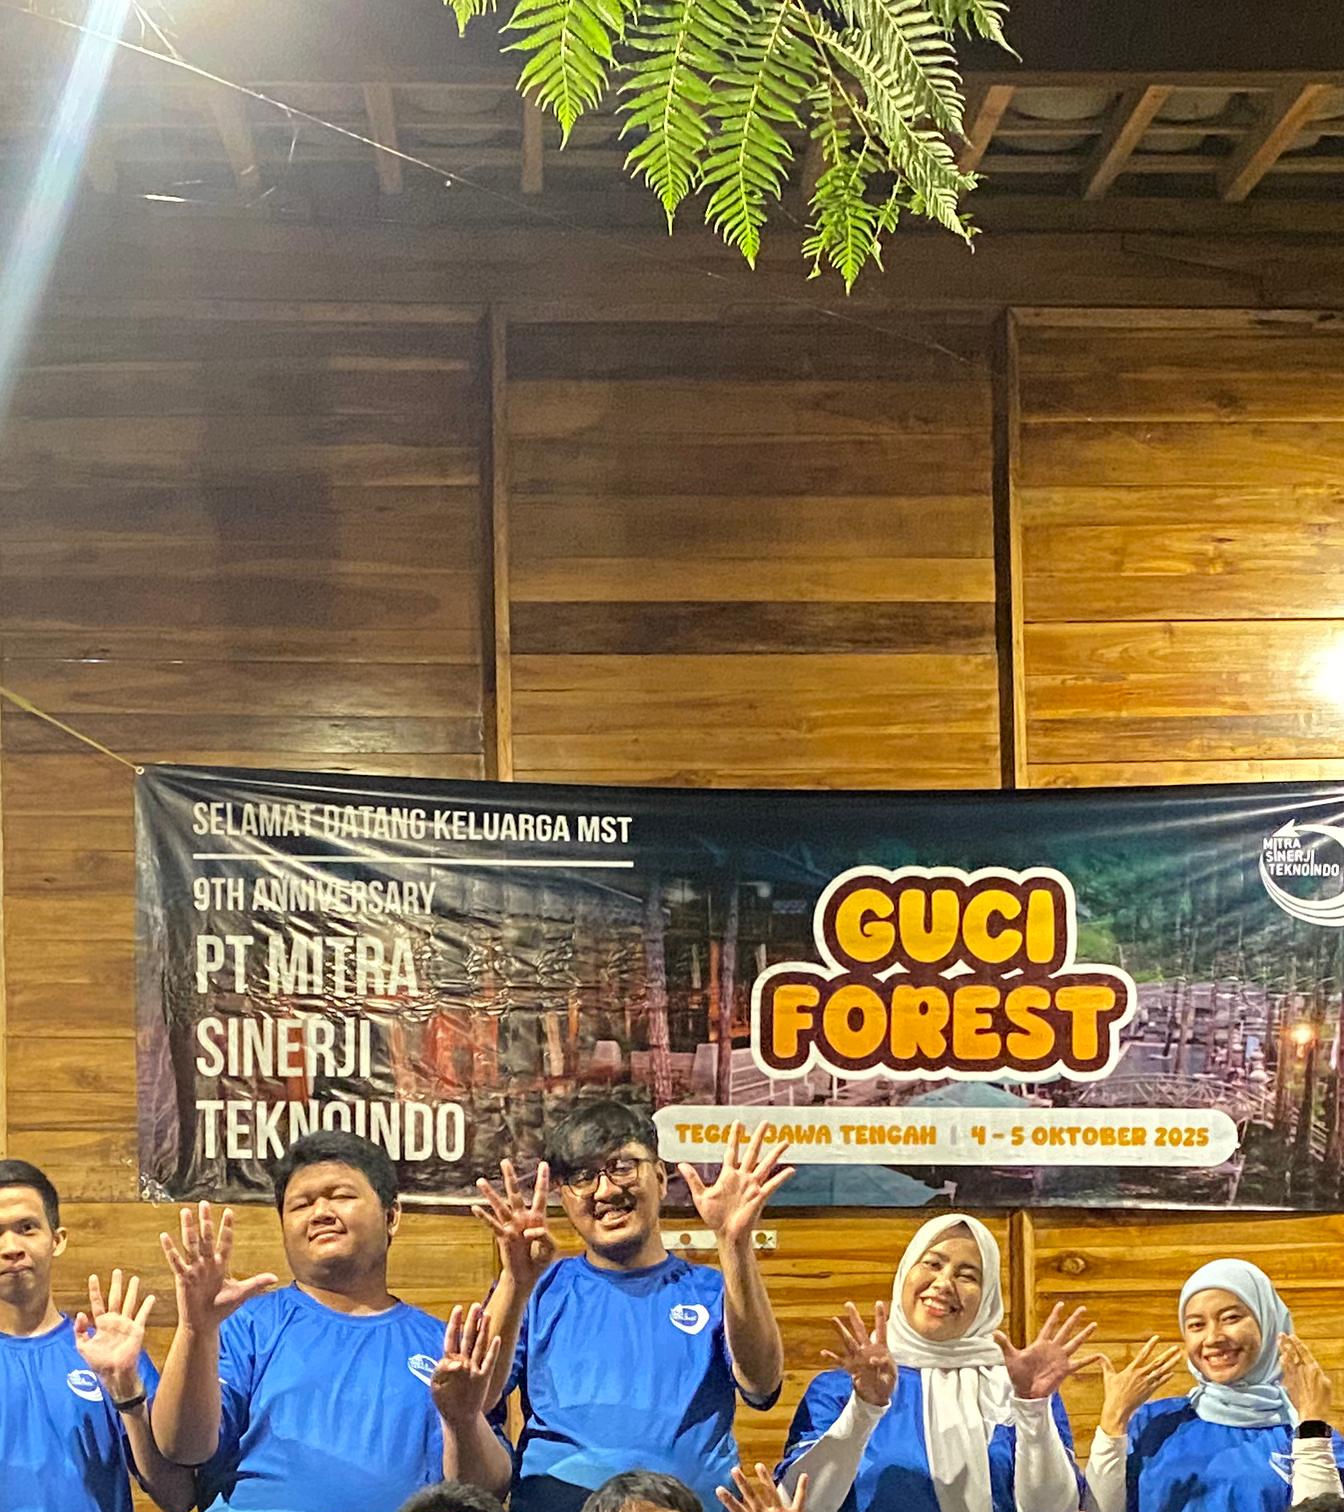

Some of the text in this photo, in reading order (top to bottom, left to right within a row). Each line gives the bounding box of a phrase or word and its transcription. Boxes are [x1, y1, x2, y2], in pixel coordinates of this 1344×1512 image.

[192, 802, 633, 844] SELAMAT DATANG KELUARGA MST
[1262, 837, 1302, 850] MITRA
[1265, 849, 1315, 863] SINERJI
[1268, 863, 1340, 877] TEKNOINDO
[193, 877, 436, 915] 9TH ANNIVERSARY
[832, 886, 1056, 966] GUCI
[195, 935, 420, 997] PT MITRA
[769, 983, 1118, 1062] FOREST
[195, 1017, 371, 1078] SINERJI
[195, 1100, 466, 1162] TEKNOINDO
[839, 1124, 937, 1145] TENGAH
[970, 1125, 986, 1145] 4
[1011, 1126, 1025, 1146] 5
[1031, 1126, 1147, 1147] OKTOBER
[1154, 1126, 1210, 1147] 2025
